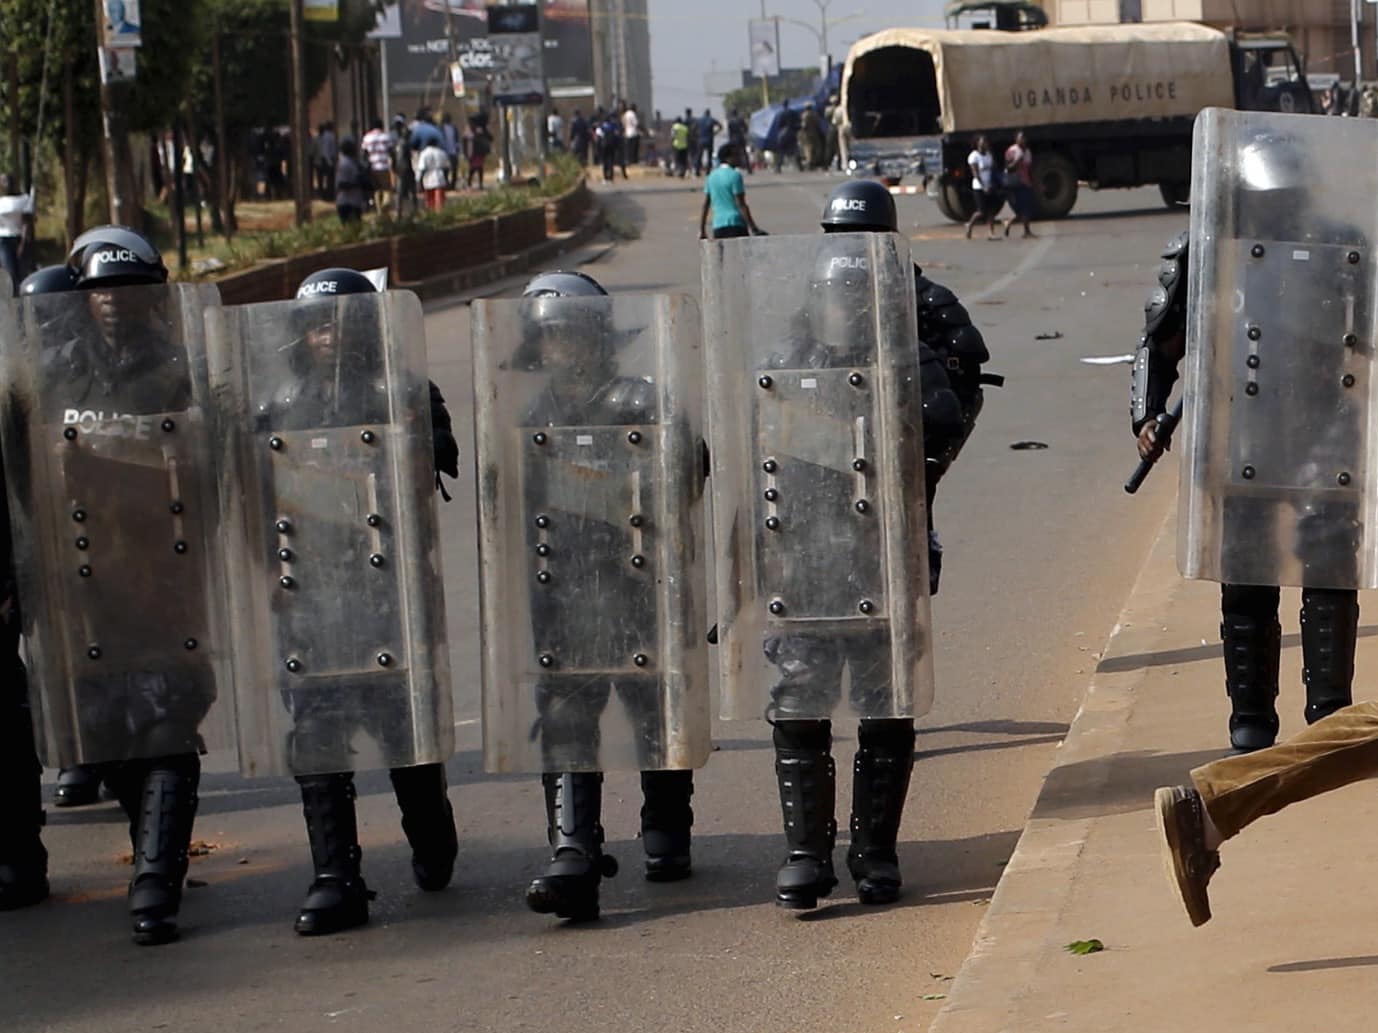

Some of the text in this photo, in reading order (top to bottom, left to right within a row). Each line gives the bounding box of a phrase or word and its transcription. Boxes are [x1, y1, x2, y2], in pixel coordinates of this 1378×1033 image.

[1011, 81, 1177, 109] UGANDA POLICE
[831, 199, 867, 211] POLICE
[94, 250, 137, 264] POLICE
[297, 281, 338, 299] POLICE
[64, 408, 152, 440] POLICE
